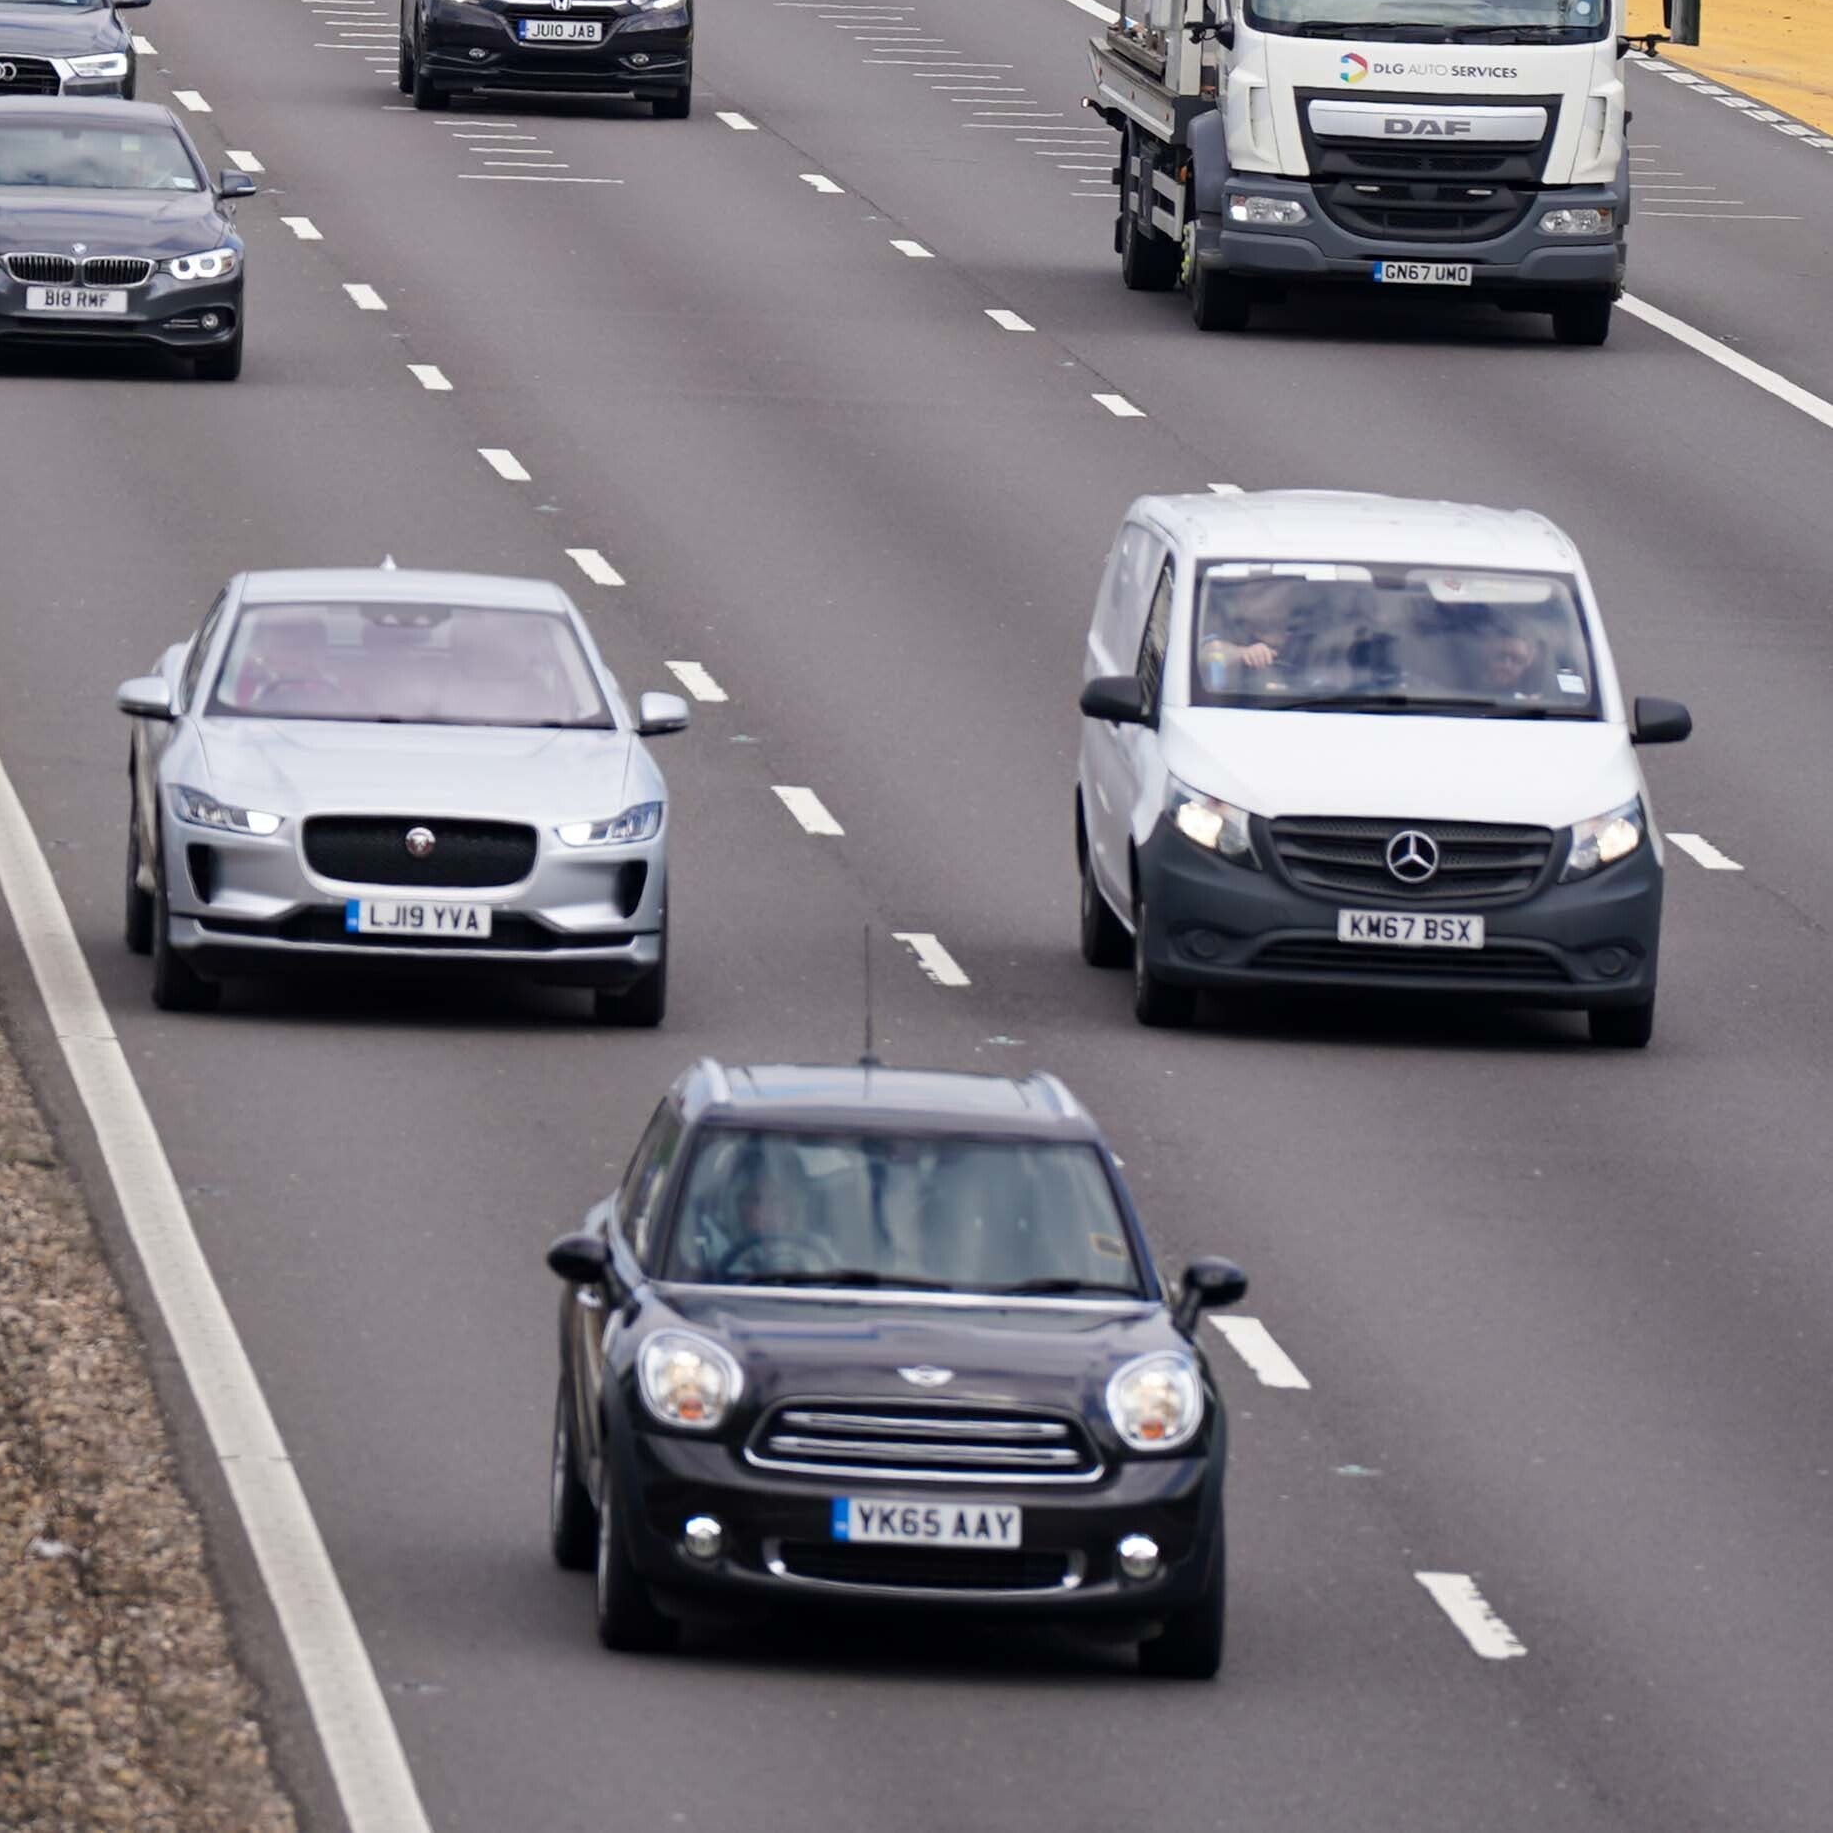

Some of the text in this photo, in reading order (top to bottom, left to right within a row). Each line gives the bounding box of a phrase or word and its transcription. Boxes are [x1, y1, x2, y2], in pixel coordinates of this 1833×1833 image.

[530, 25, 595, 39] JU10 JAB
[1373, 62, 1519, 80] DLG AUTO SERVICES
[1383, 118, 1472, 137] DAF
[1385, 262, 1470, 285] GN67 UMO
[44, 291, 71, 307] B18
[369, 904, 480, 933] LJ19 YVA
[1348, 916, 1474, 943] KM67 BSX
[857, 1505, 1015, 1542] YK65 AAY
